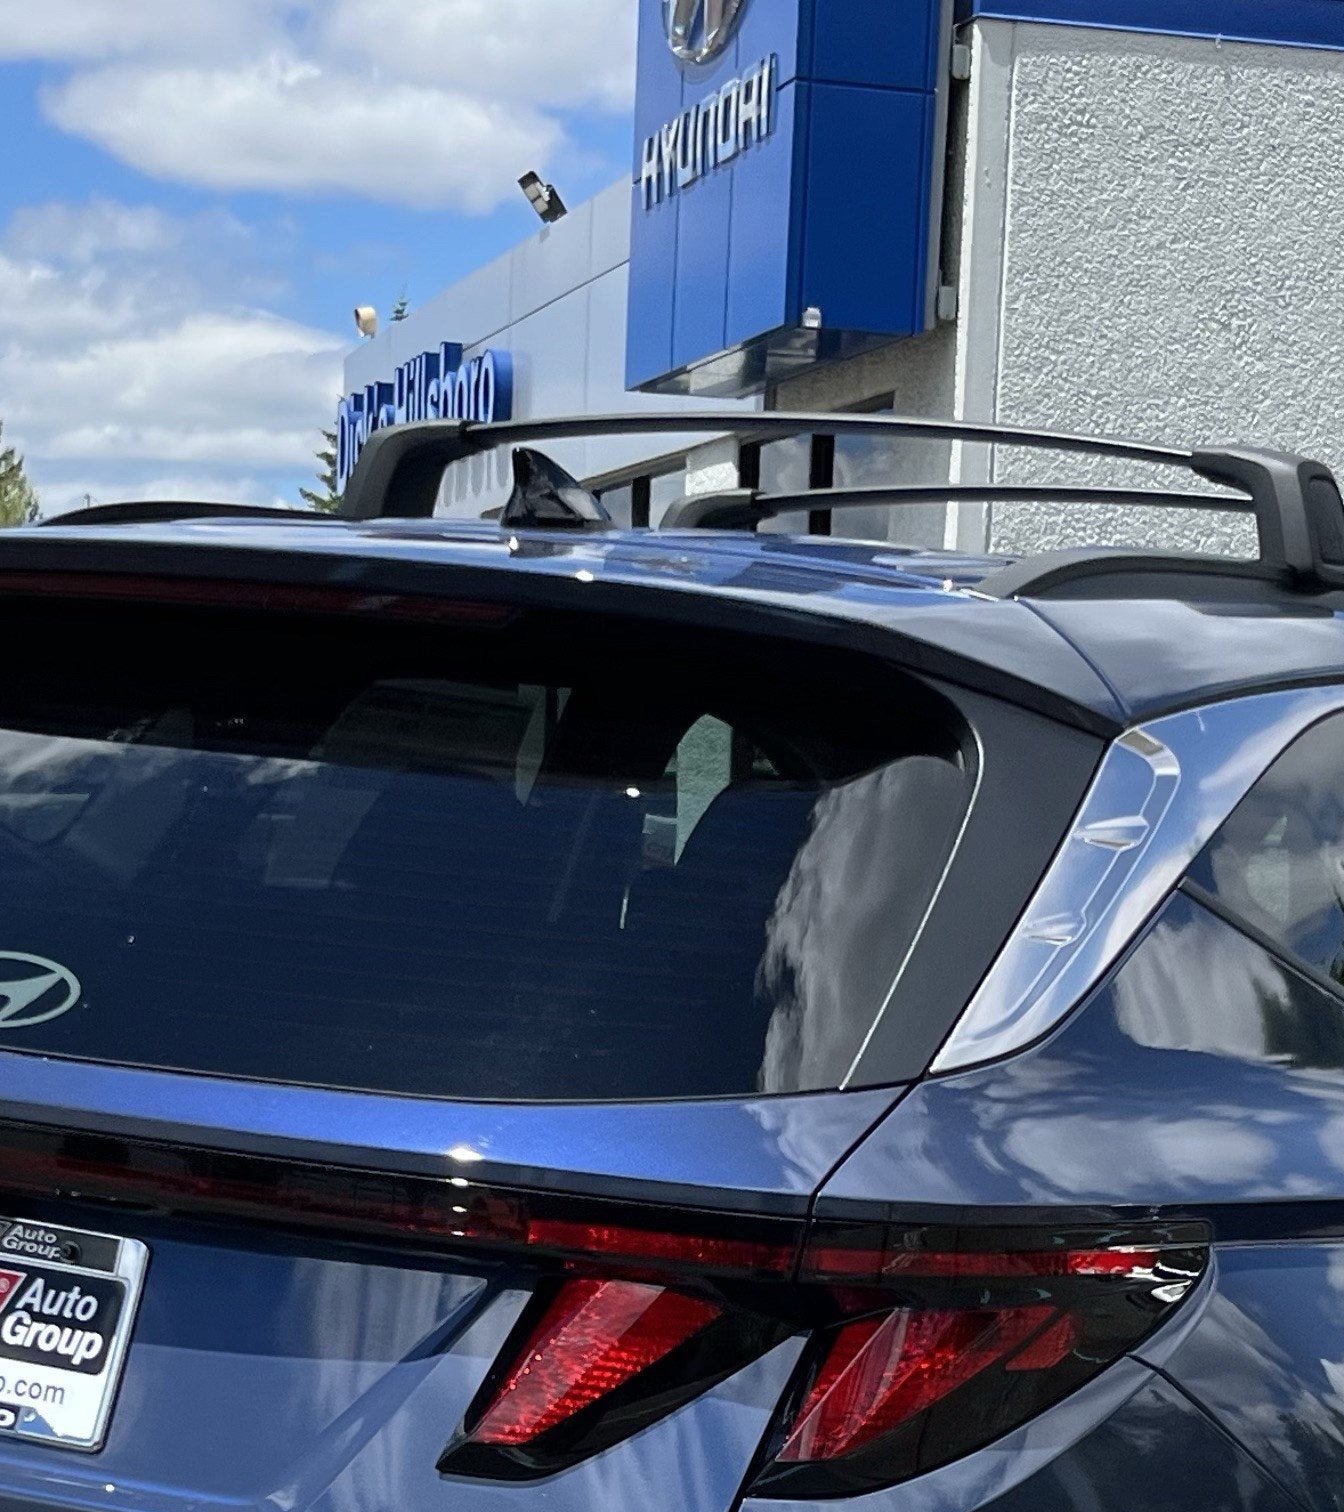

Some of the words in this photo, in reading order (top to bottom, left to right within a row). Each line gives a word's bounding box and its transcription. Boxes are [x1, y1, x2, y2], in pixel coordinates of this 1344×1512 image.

[641, 54, 776, 210] HYUNDAI
[12, 1223, 58, 1244] Auto
[15, 1277, 99, 1322] Auto
[1, 1311, 104, 1365] Group
